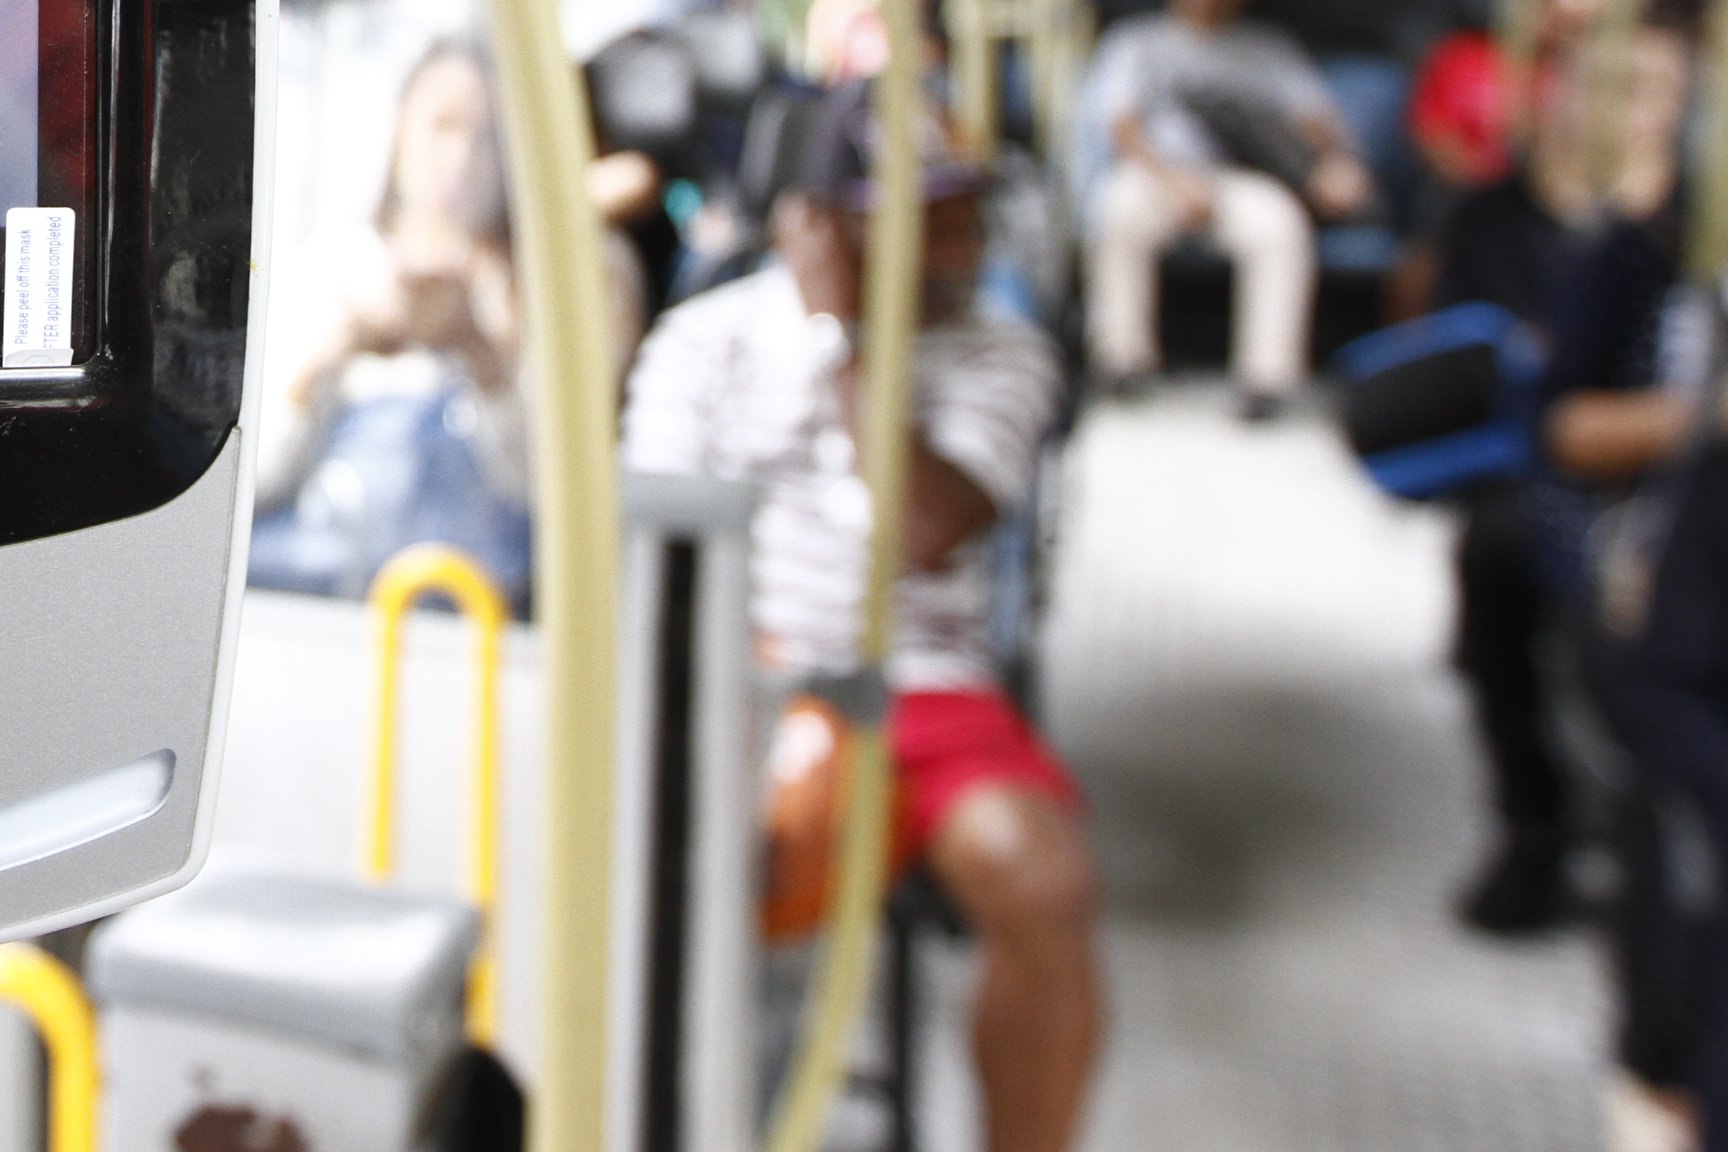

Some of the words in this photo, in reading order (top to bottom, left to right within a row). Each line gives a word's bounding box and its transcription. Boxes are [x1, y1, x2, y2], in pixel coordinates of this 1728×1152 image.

[18, 230, 31, 254] mask
[48, 216, 64, 266] completed
[17, 257, 30, 273] this
[16, 275, 30, 287] off
[16, 290, 31, 310] peel
[45, 269, 61, 321] application
[14, 313, 28, 344] Please
